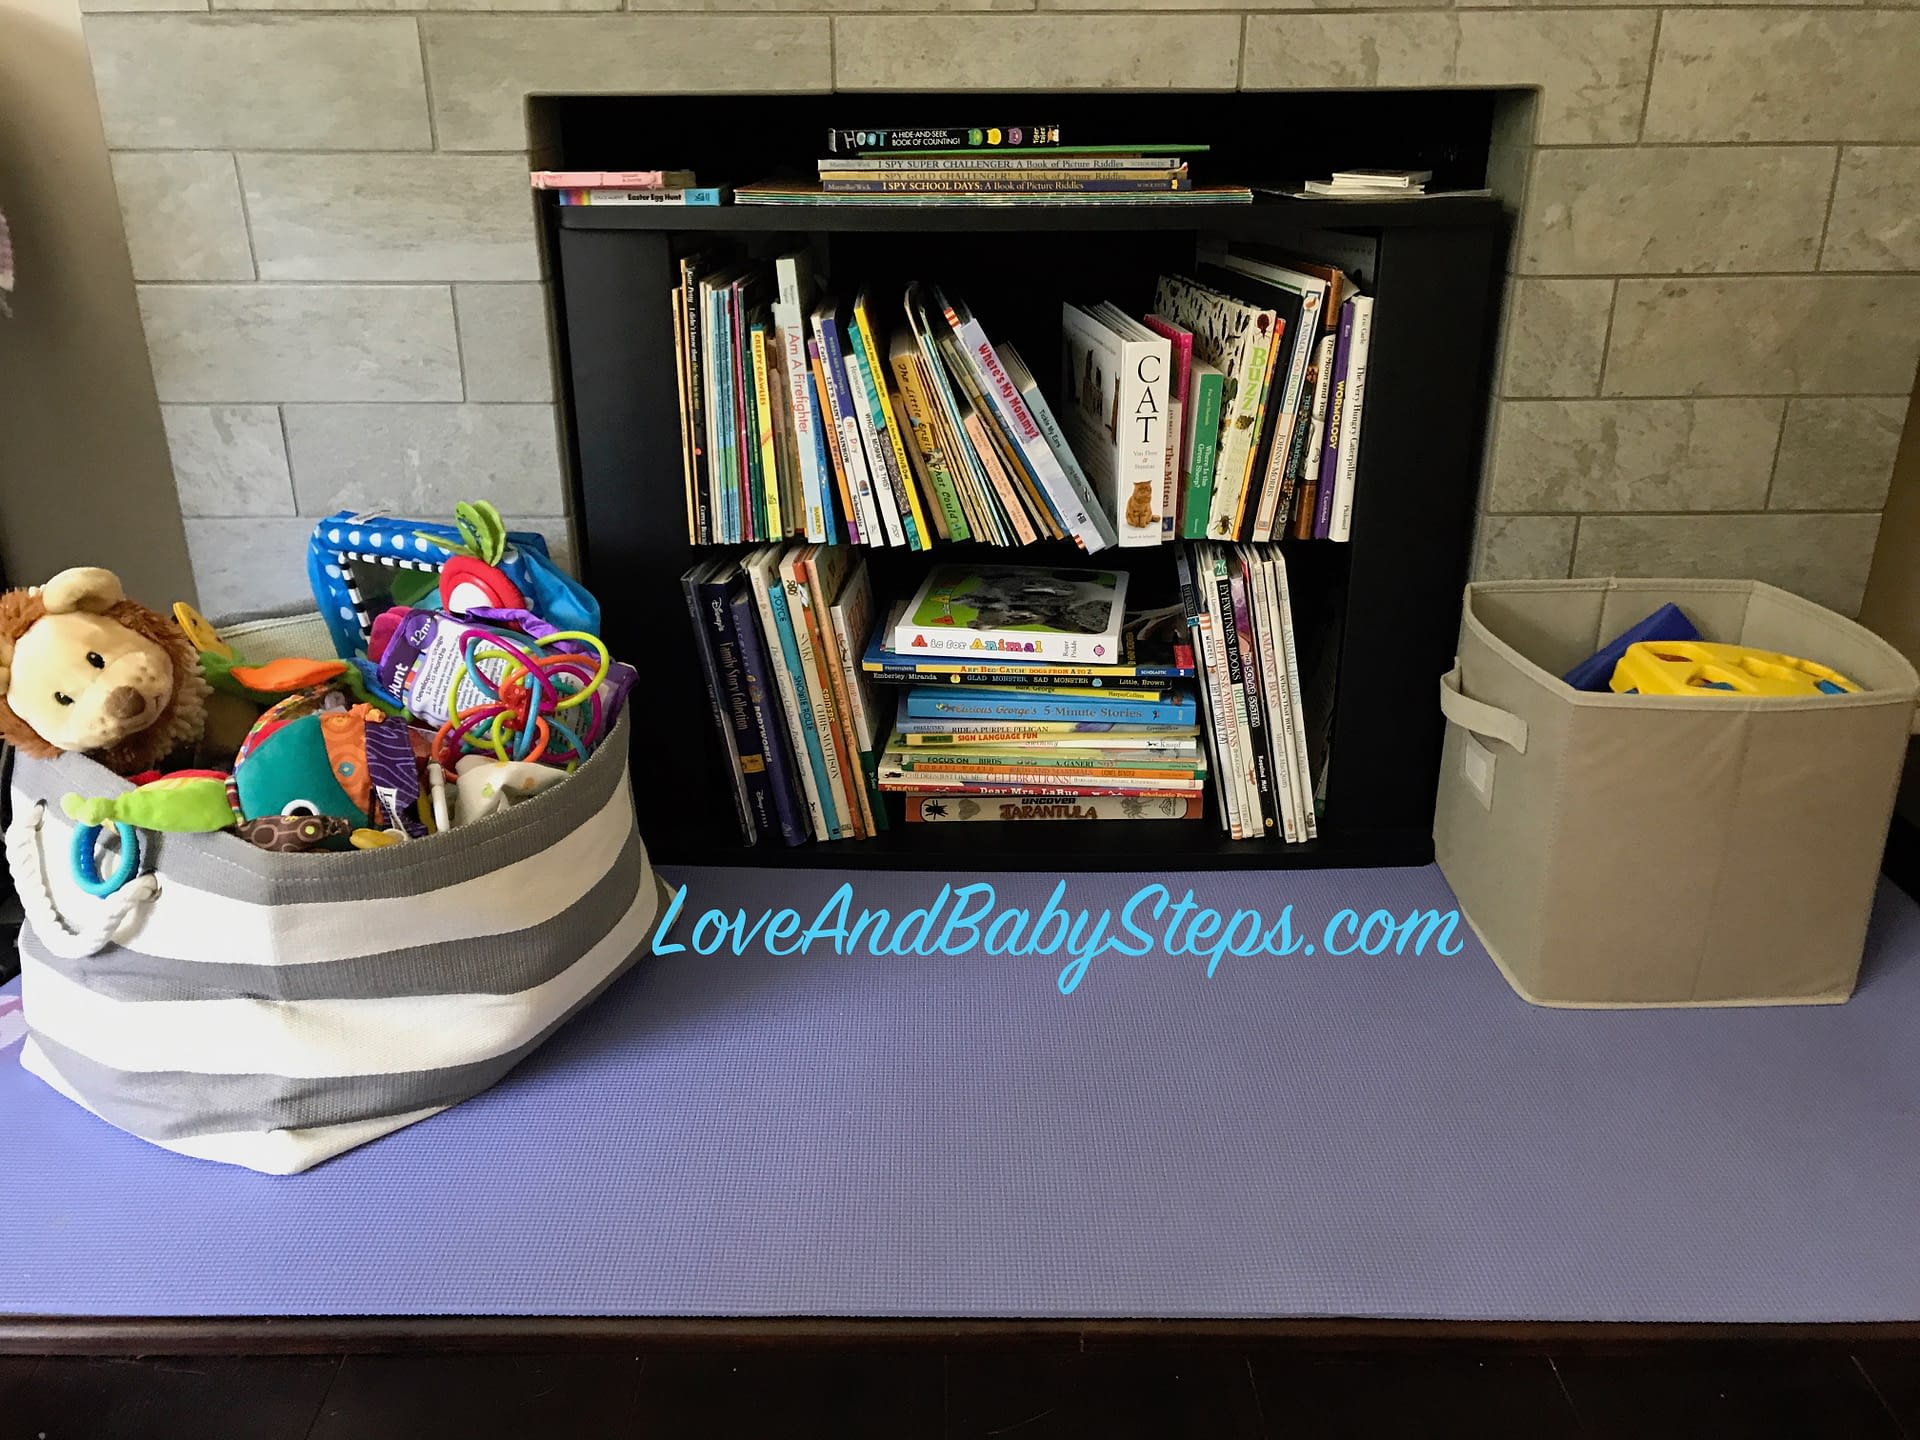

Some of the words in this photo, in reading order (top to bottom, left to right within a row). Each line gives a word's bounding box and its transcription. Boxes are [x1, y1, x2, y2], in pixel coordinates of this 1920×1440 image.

[844, 130, 887, 149] HOOT
[899, 130, 948, 138] HIDE-AND-SEEK
[907, 172, 936, 180] GOLD
[908, 160, 939, 168] SUPER
[1017, 160, 1022, 168] A
[1026, 160, 1047, 168] Book
[1051, 160, 1059, 168] of
[1063, 160, 1089, 168] Picture
[1094, 160, 1123, 168] Riddles
[883, 182, 886, 190] I
[888, 182, 907, 190] SPY
[910, 182, 951, 190] SCHOOL
[953, 182, 982, 190] DAYS:
[985, 182, 992, 190] A
[994, 182, 1014, 190] Book
[1016, 182, 1025, 190] of
[1026, 182, 1053, 190] Picture
[1055, 181, 1083, 189] Riddles
[1361, 313, 1369, 327] Eric
[788, 332, 801, 354] Am
[1297, 320, 1310, 354] ANIMAL
[1326, 339, 1334, 355] The
[1359, 327, 1367, 344] Carle
[791, 358, 803, 369] A
[976, 342, 1006, 384] Where's
[1322, 356, 1332, 381] Moon
[1355, 365, 1365, 381] The
[756, 365, 767, 405] CRAWLIES
[998, 381, 1015, 399] My
[1241, 347, 1266, 412] BUZZ
[1286, 373, 1299, 403] ROUND
[1320, 382, 1328, 398] and
[1352, 383, 1363, 401] Very
[790, 372, 812, 435] Firefighter
[1135, 355, 1161, 443] CAT
[1318, 400, 1326, 417] You
[826, 376, 835, 397] LET'S
[831, 399, 840, 420] PAINT
[837, 430, 849, 463] RAINBOW
[1006, 395, 1040, 441] Mommy?
[1038, 408, 1051, 426] Tickle
[1045, 424, 1055, 435] My
[1328, 379, 1344, 449] WORMOLOGY
[1348, 404, 1361, 435] Hungry
[865, 412, 875, 435] WHOSE
[871, 437, 882, 464] MOMMY
[879, 472, 889, 491] THIS?
[897, 362, 911, 383] The
[904, 384, 923, 418] Little
[941, 490, 958, 520] Could
[1197, 443, 1205, 464] Green
[1272, 433, 1286, 465] JOHNNY
[1164, 445, 1174, 467] The
[1203, 445, 1211, 465] Where
[1343, 437, 1358, 480] Caterpillar
[1193, 464, 1203, 488] Sheep?
[1203, 467, 1209, 475] Is
[1266, 466, 1279, 497] MORRIS
[1162, 471, 1172, 507] Mitten
[1214, 561, 1227, 575] 26
[708, 596, 728, 632] Disney's
[912, 634, 928, 648] A
[931, 638, 942, 648] is
[946, 639, 966, 649] for
[970, 638, 1043, 653] Animal
[1218, 583, 1236, 644] EYEWITNESS
[1227, 646, 1241, 681] BOOKS
[434, 648, 446, 674] Months
[718, 641, 738, 668] Family
[1260, 630, 1275, 677] AMAZING
[1283, 629, 1295, 666] ANIMAL
[773, 593, 787, 622] JOYCE
[802, 707, 814, 731] ROLIE
[388, 662, 408, 698] Hunt
[725, 668, 743, 692] Story
[1214, 638, 1228, 680] REPTILES
[1222, 691, 1238, 747] AMPHIBIANS
[1243, 665, 1256, 694] SOLAR
[1288, 672, 1300, 705] HOMES
[820, 687, 836, 723] SPIDERS
[1233, 688, 1248, 726] REPTILE
[1267, 681, 1279, 709] BUGS
[729, 691, 752, 730] Collection
[814, 703, 829, 731] CHRIS
[954, 704, 992, 714] Curious
[996, 705, 1037, 716] George's
[1101, 709, 1142, 718] Stories
[1214, 712, 1225, 725] SAW
[1247, 695, 1261, 727] SYSTEM
[753, 705, 773, 762] BODYWORKS
[958, 734, 976, 742] SIGN
[979, 733, 1020, 741] LANGUAGE
[1275, 732, 1284, 757] Miranda
[821, 732, 840, 779] MATTISON
[1022, 797, 1076, 805] UNCOVER
[1041, 788, 1079, 796] LaRue
[999, 804, 1098, 819] TARANTULA
